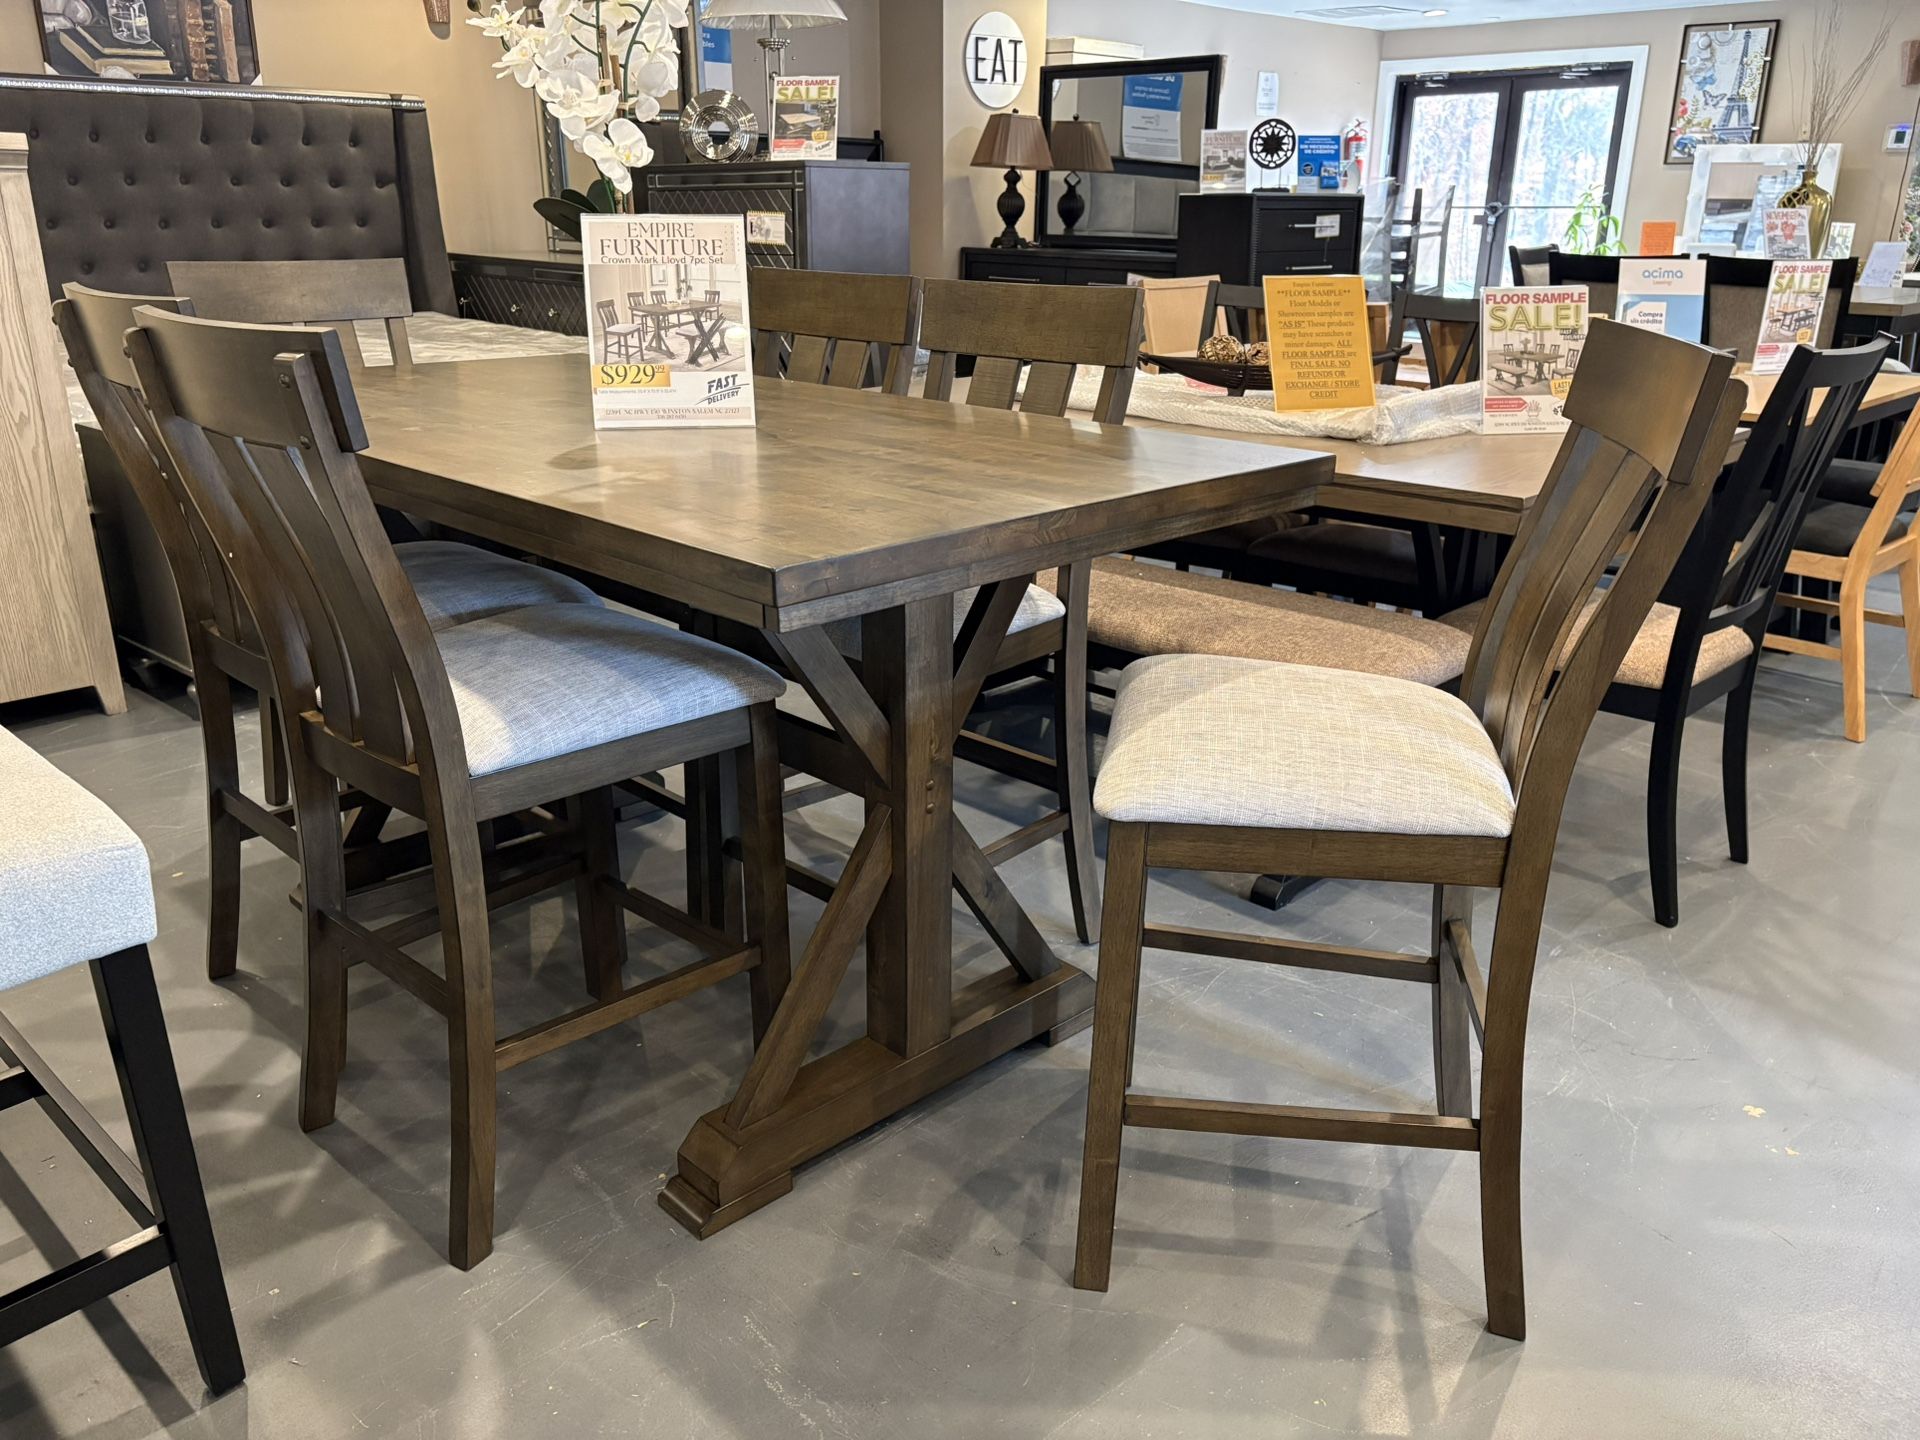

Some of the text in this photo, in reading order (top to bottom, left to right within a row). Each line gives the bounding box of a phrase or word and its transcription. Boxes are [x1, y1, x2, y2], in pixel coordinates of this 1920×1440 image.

[974, 37, 1023, 83] EAT
[777, 86, 835, 102] SALE!
[627, 222, 695, 238] EMPIRE
[600, 238, 724, 256] FURNITURE
[600, 255, 723, 266] Crown Mark Lloyd 7pc Set
[1642, 267, 1684, 279] acima
[1773, 264, 1831, 274] FLOOR SAMPLE
[1771, 273, 1826, 294] SALE!
[1485, 292, 1587, 304] FLOOR SAMPLE
[1316, 311, 1343, 319] samples
[1489, 304, 1582, 332] SALE!
[1336, 339, 1352, 347] ALL
[1282, 350, 1308, 359] FLOOR
[1309, 349, 1345, 358] SAMPLES
[1290, 360, 1314, 369] FINAL
[1338, 360, 1351, 368] NO
[601, 364, 655, 385] $929
[1297, 370, 1333, 379] REFUNDS
[707, 374, 738, 394] FAST
[1285, 381, 1329, 390] EXCHANGE
[1334, 380, 1360, 388] STORE
[708, 390, 739, 405] DELIVERY
[1309, 390, 1338, 399] CREDIT
